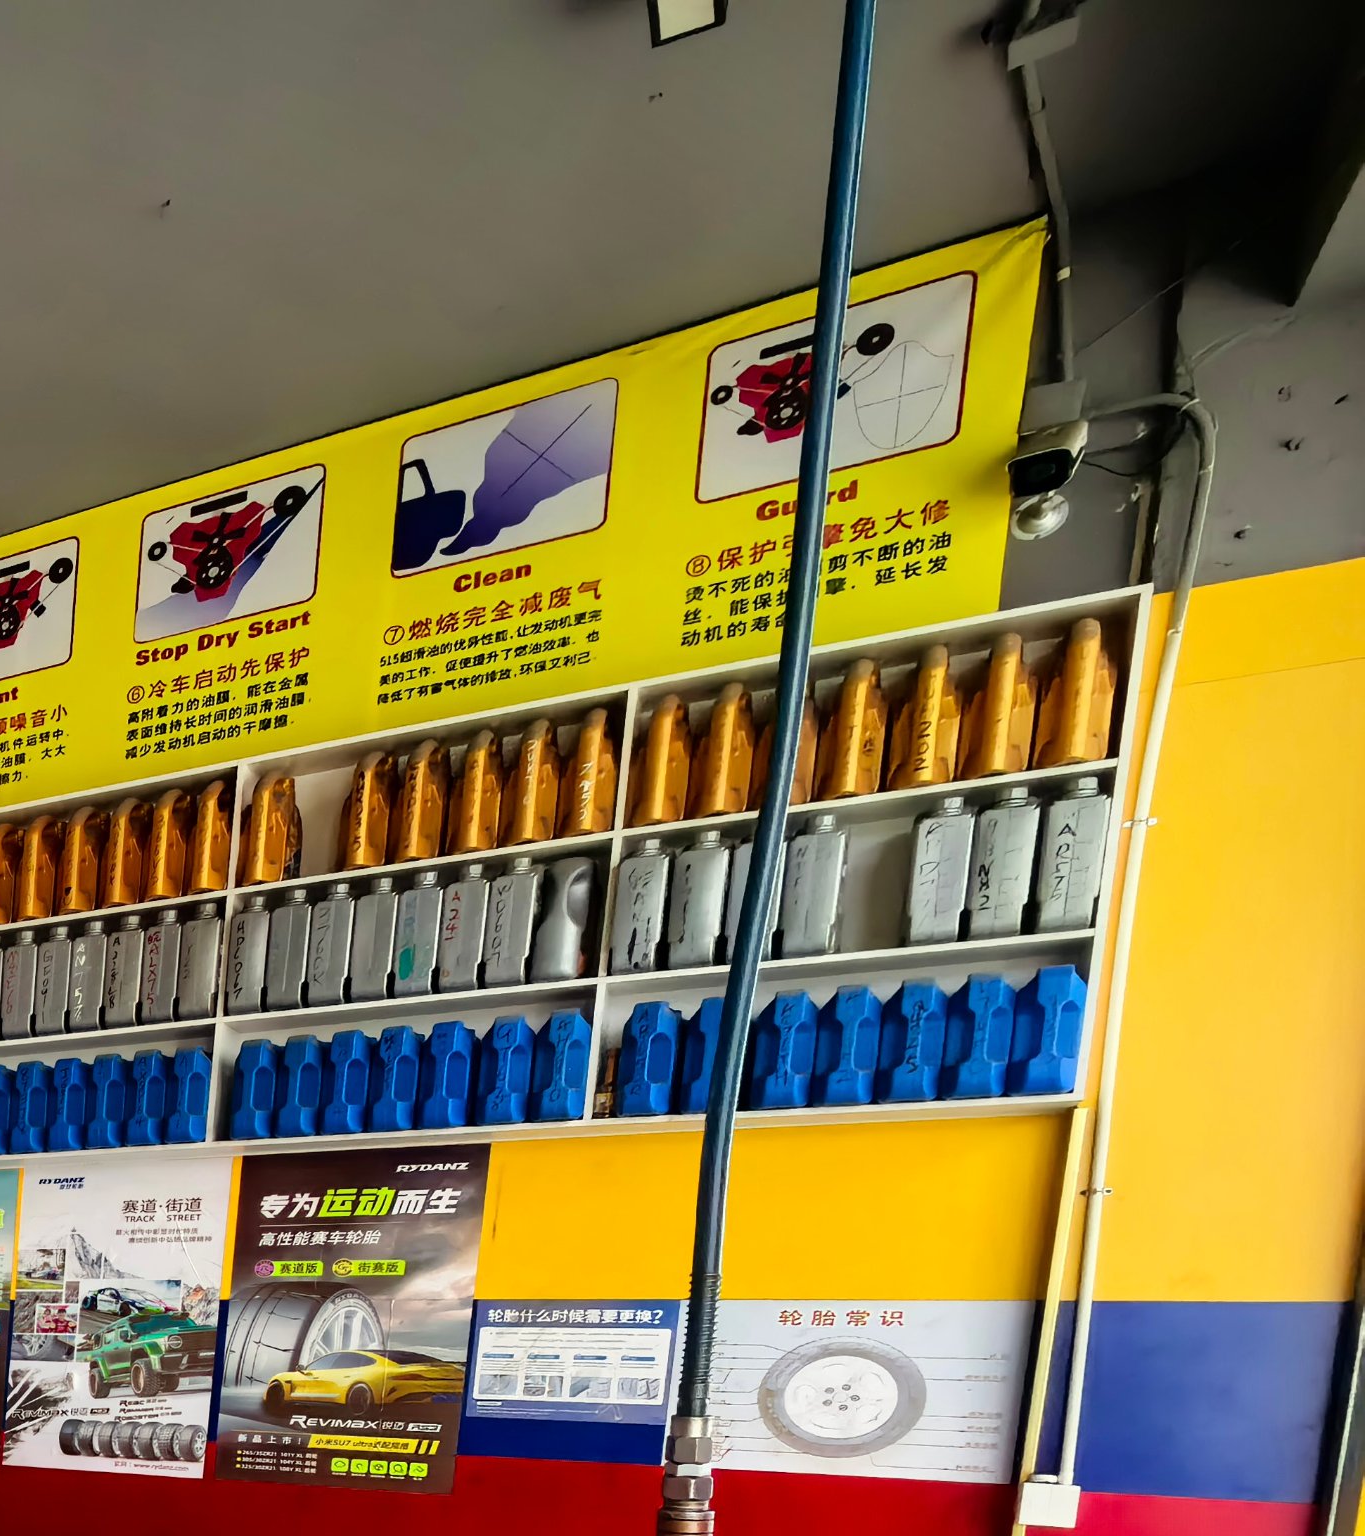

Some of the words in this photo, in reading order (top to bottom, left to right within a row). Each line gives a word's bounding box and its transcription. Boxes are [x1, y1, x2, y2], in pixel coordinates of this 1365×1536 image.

[756, 479, 858, 521] Gurd
[685, 532, 952, 604] 烫不死的油剪不断的油
[453, 564, 532, 593] Clean
[135, 643, 189, 666] Stop
[197, 630, 240, 652] Dry
[248, 610, 311, 639] Start
[395, 1161, 470, 1173] RYDANZ
[259, 1186, 463, 1219] 专为运动而生
[124, 1214, 156, 1223] TRACK
[166, 1213, 202, 1222] STREET
[258, 1230, 382, 1248] 高性能赛车轮胎
[279, 1261, 320, 1275] 赛道版
[357, 1260, 400, 1274] 街赛版
[778, 1310, 905, 1327] 轮胎常识
